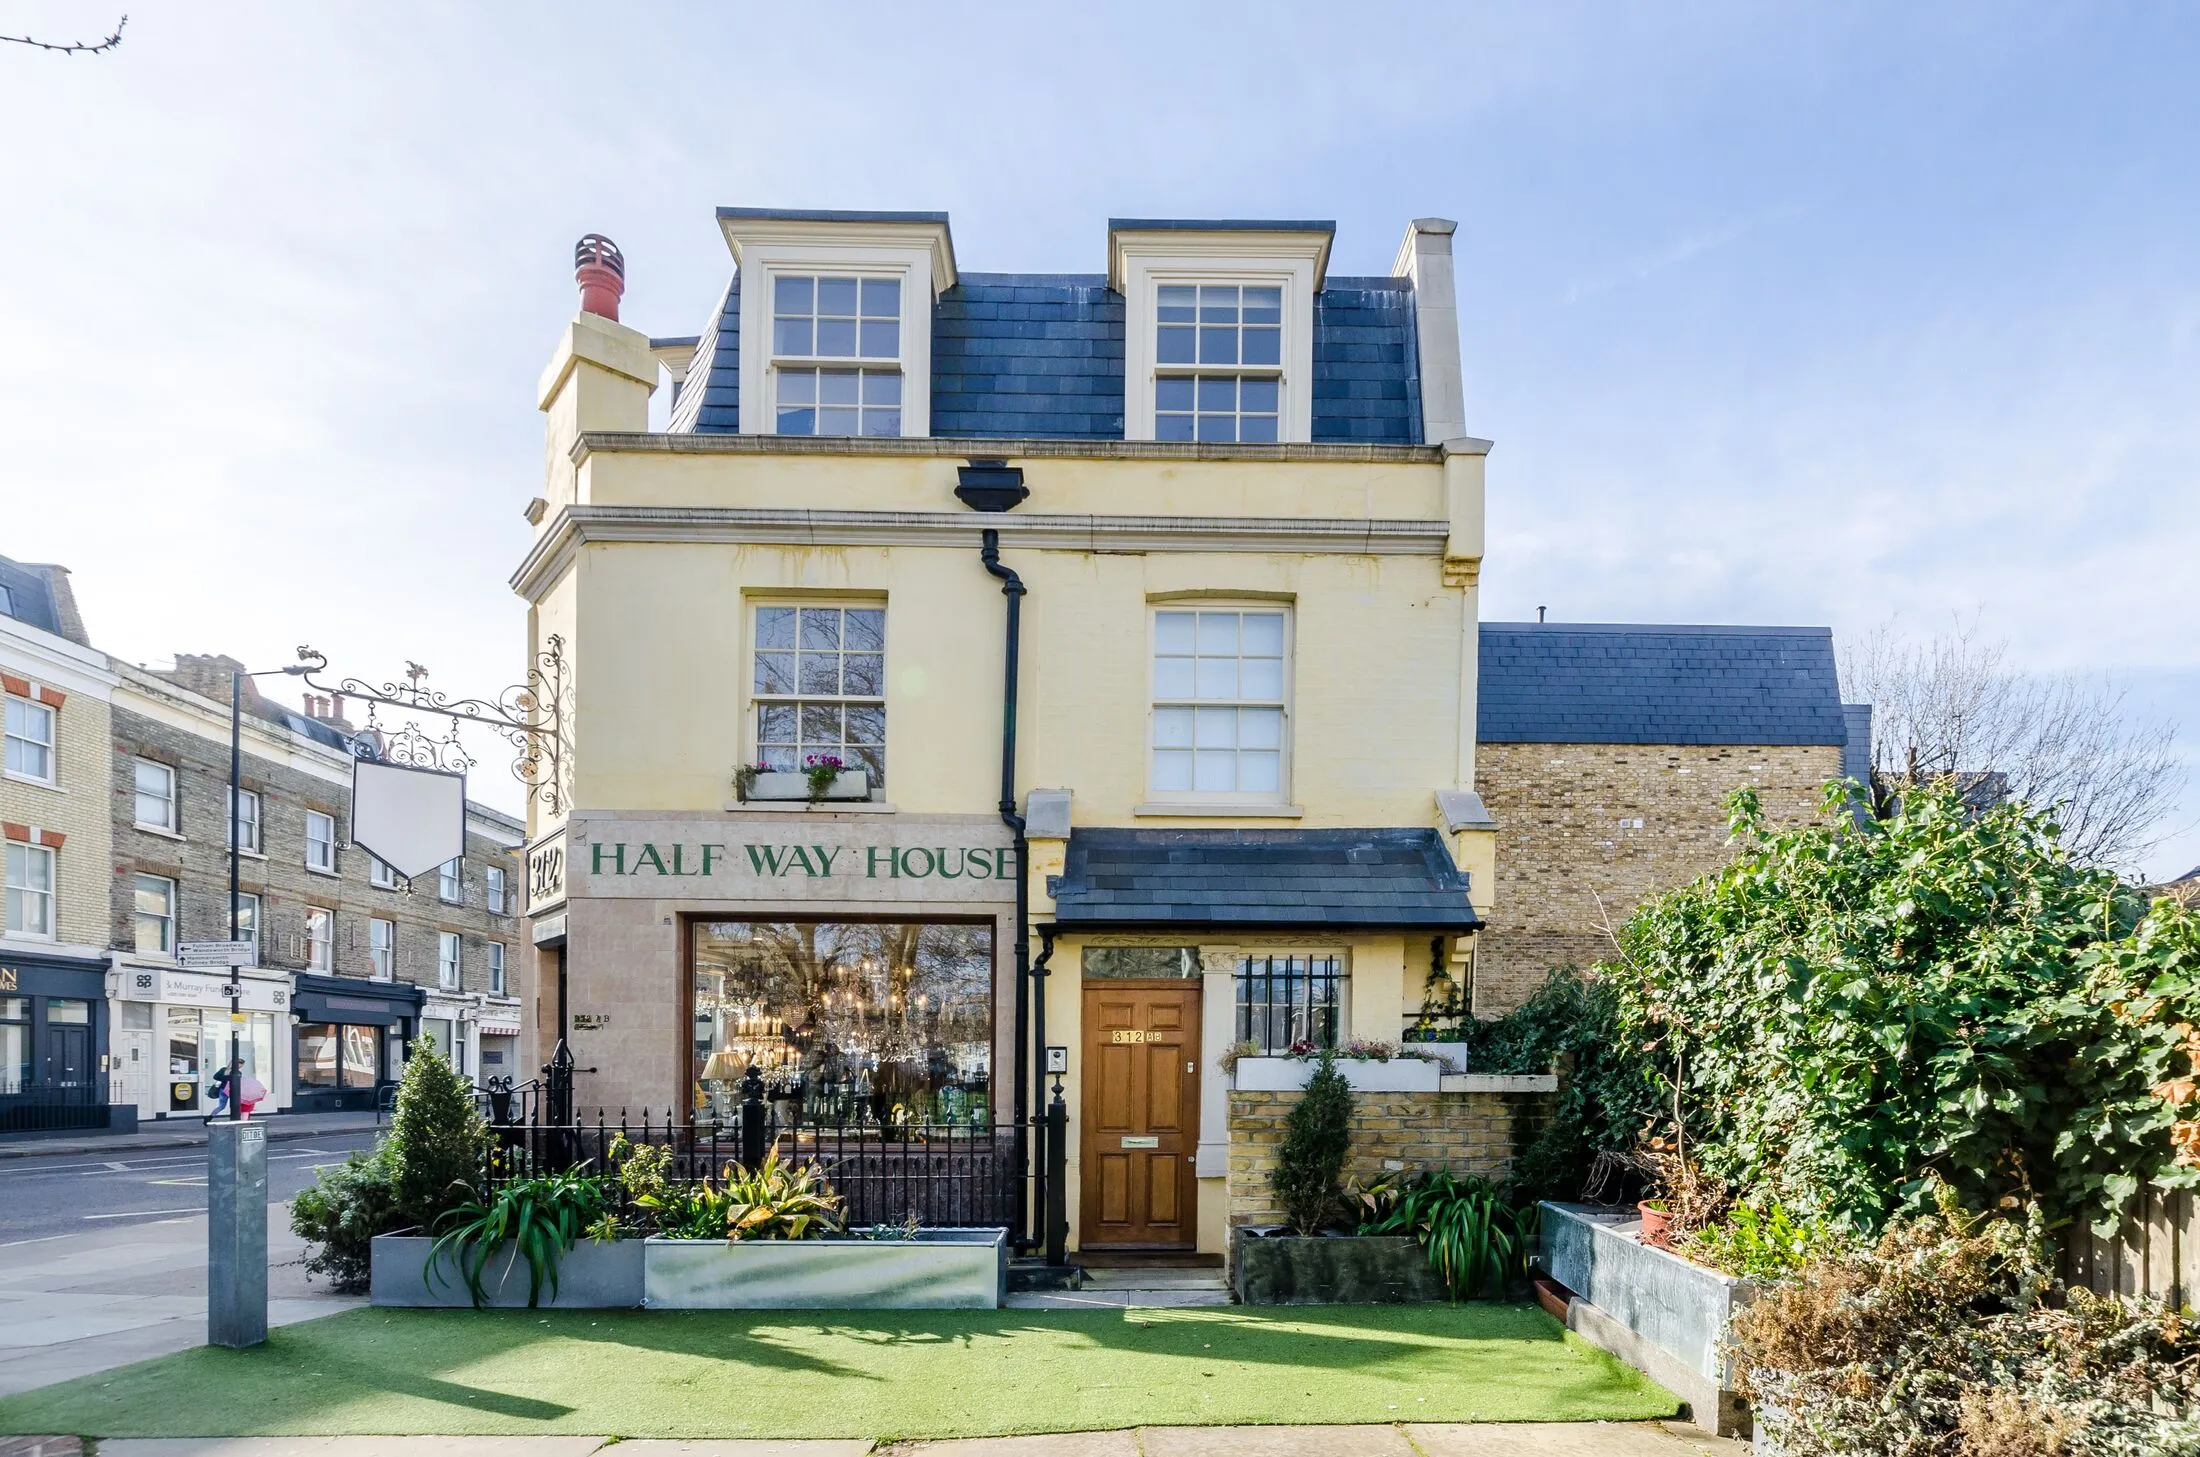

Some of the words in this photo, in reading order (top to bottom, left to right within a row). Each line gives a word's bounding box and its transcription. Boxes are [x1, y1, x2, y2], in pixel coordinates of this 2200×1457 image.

[531, 846, 564, 895] 312
[591, 842, 726, 876] HALF
[744, 844, 842, 878] WAY
[866, 846, 1017, 880] HOUSE
[1114, 1031, 1142, 1043] 312
